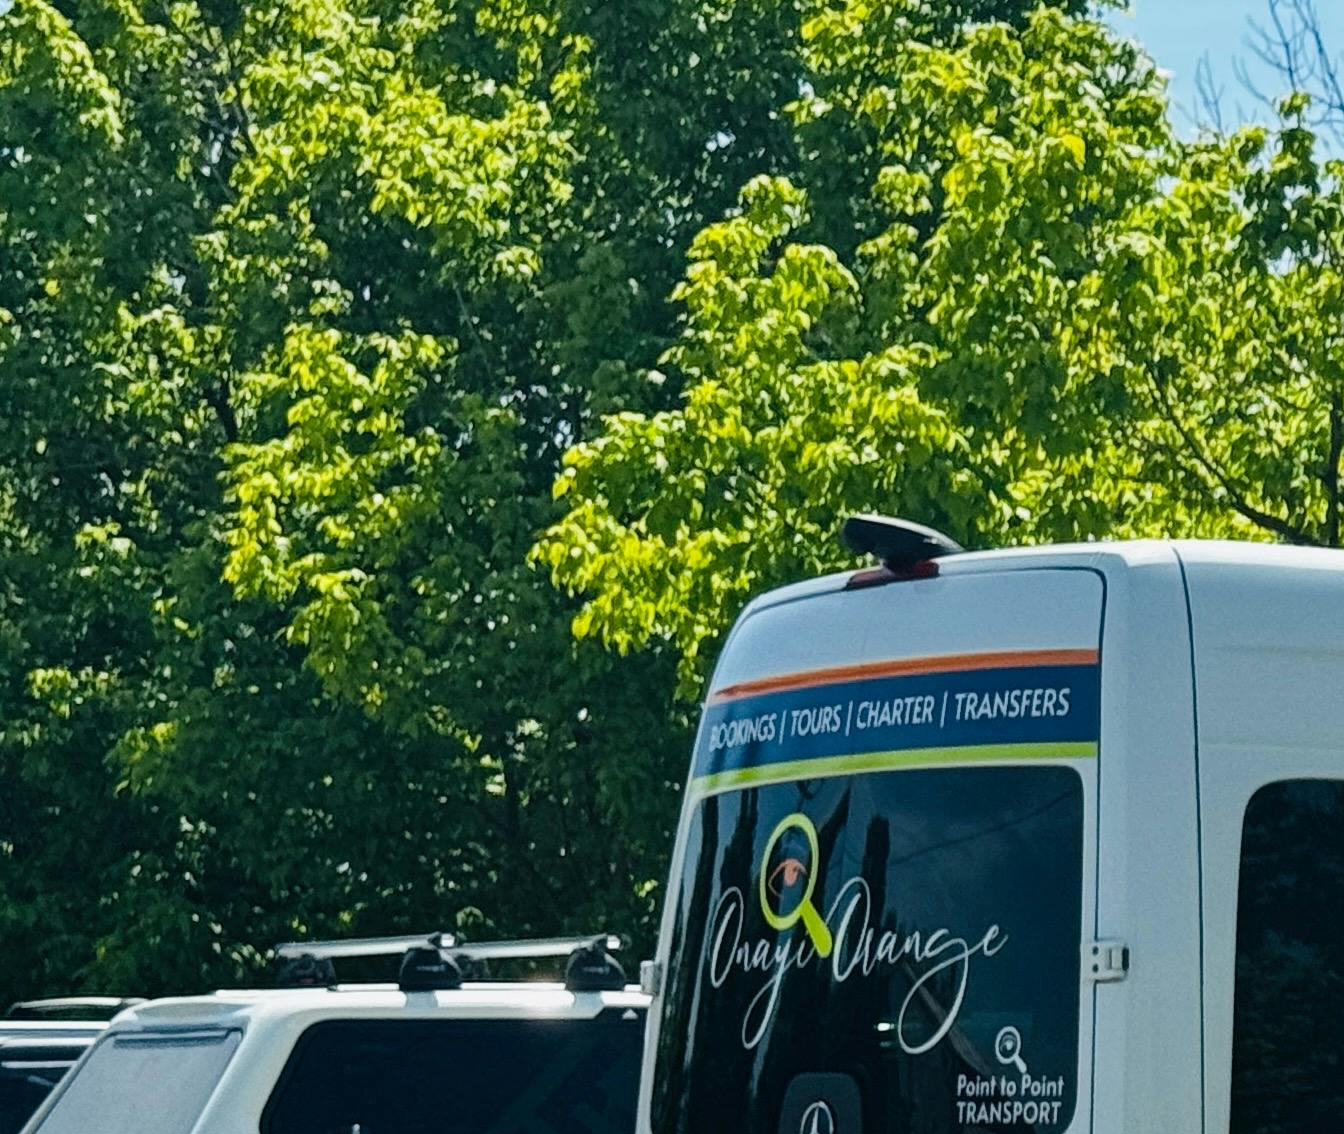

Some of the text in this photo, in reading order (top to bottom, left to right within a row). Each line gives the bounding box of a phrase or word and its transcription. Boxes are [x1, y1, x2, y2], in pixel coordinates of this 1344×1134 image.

[709, 713, 777, 750] BOOKINGS
[791, 705, 842, 737] TOURS
[856, 695, 934, 730] CHARTER
[955, 688, 1071, 721] TRANSFERS
[826, 876, 1009, 1054] Orange
[957, 1074, 1064, 1097] Point to Point
[956, 1101, 1062, 1125] TRANSPORT
